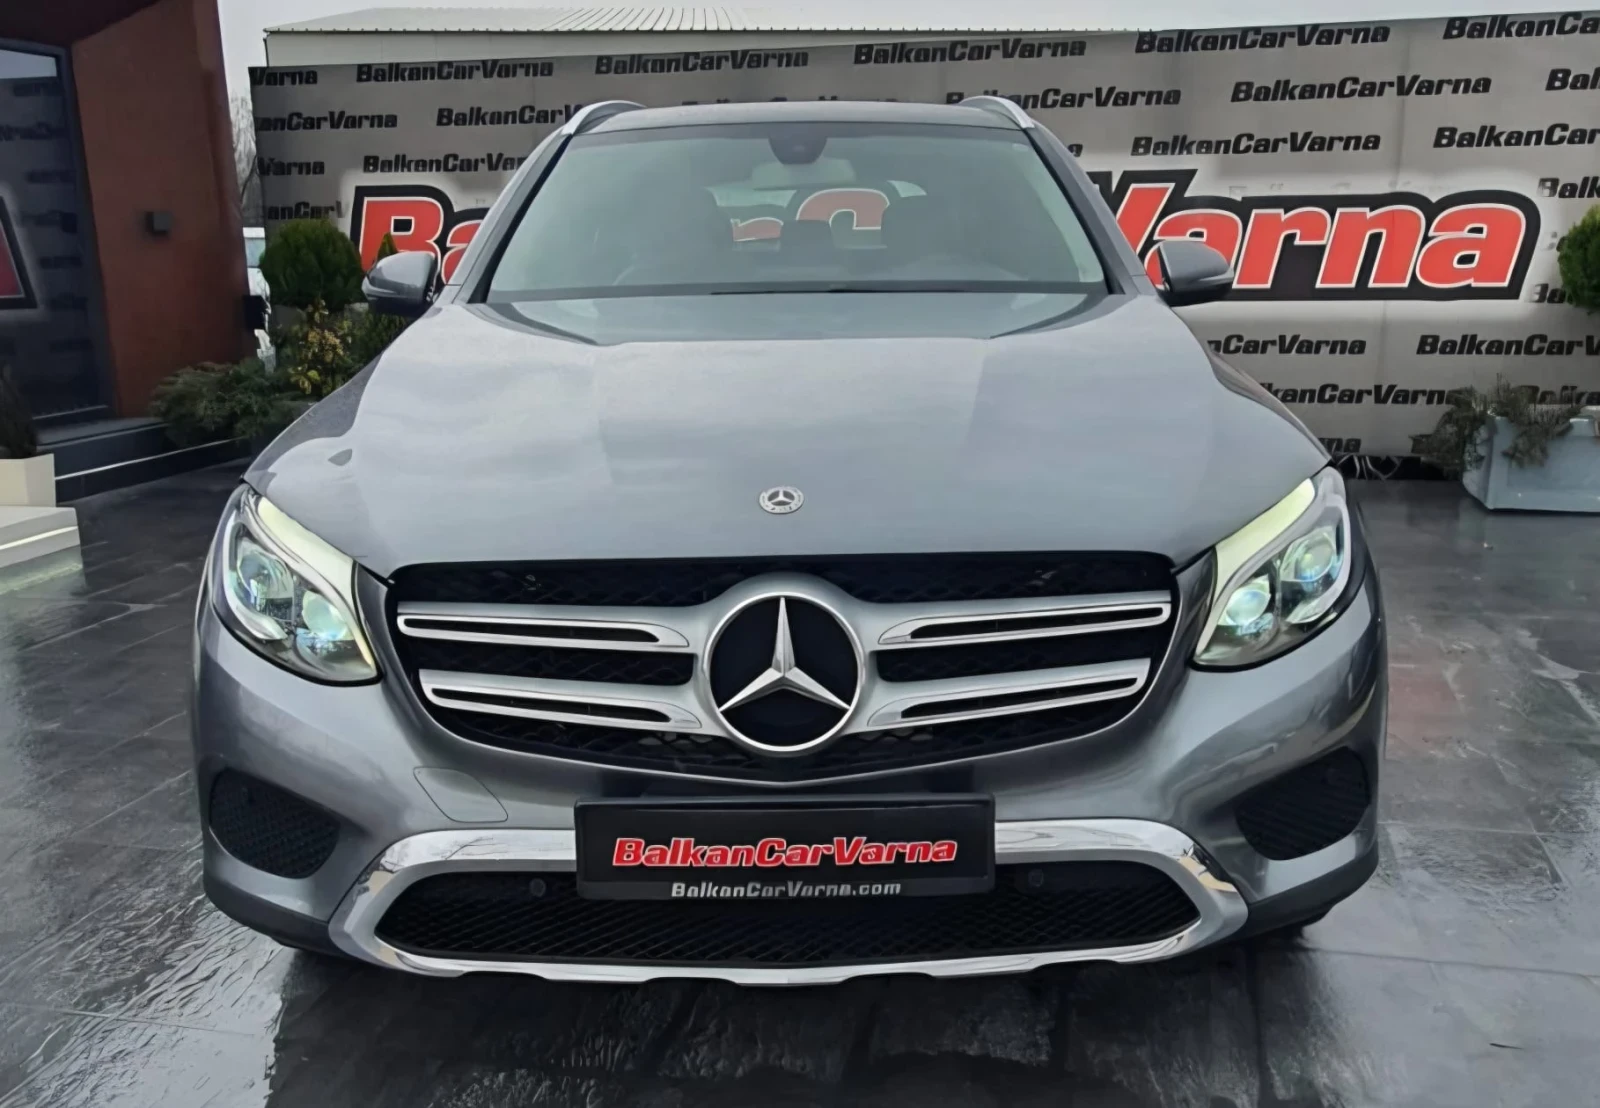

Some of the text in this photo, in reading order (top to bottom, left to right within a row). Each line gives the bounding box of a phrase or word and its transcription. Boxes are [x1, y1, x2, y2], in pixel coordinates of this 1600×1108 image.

[853, 39, 1087, 65] BalkanCarVarna
[1135, 25, 1391, 54] BalkanCarVarna
[356, 60, 553, 83] BalkanCarVarna
[595, 51, 809, 75] BalkanCarVarna
[1230, 75, 1492, 103] BalkanCarVarna
[1130, 132, 1381, 157] BalkanCarVarna
[612, 837, 958, 867] BalkanCarVarna
[671, 881, 901, 898] BalkanCarVarna.com
